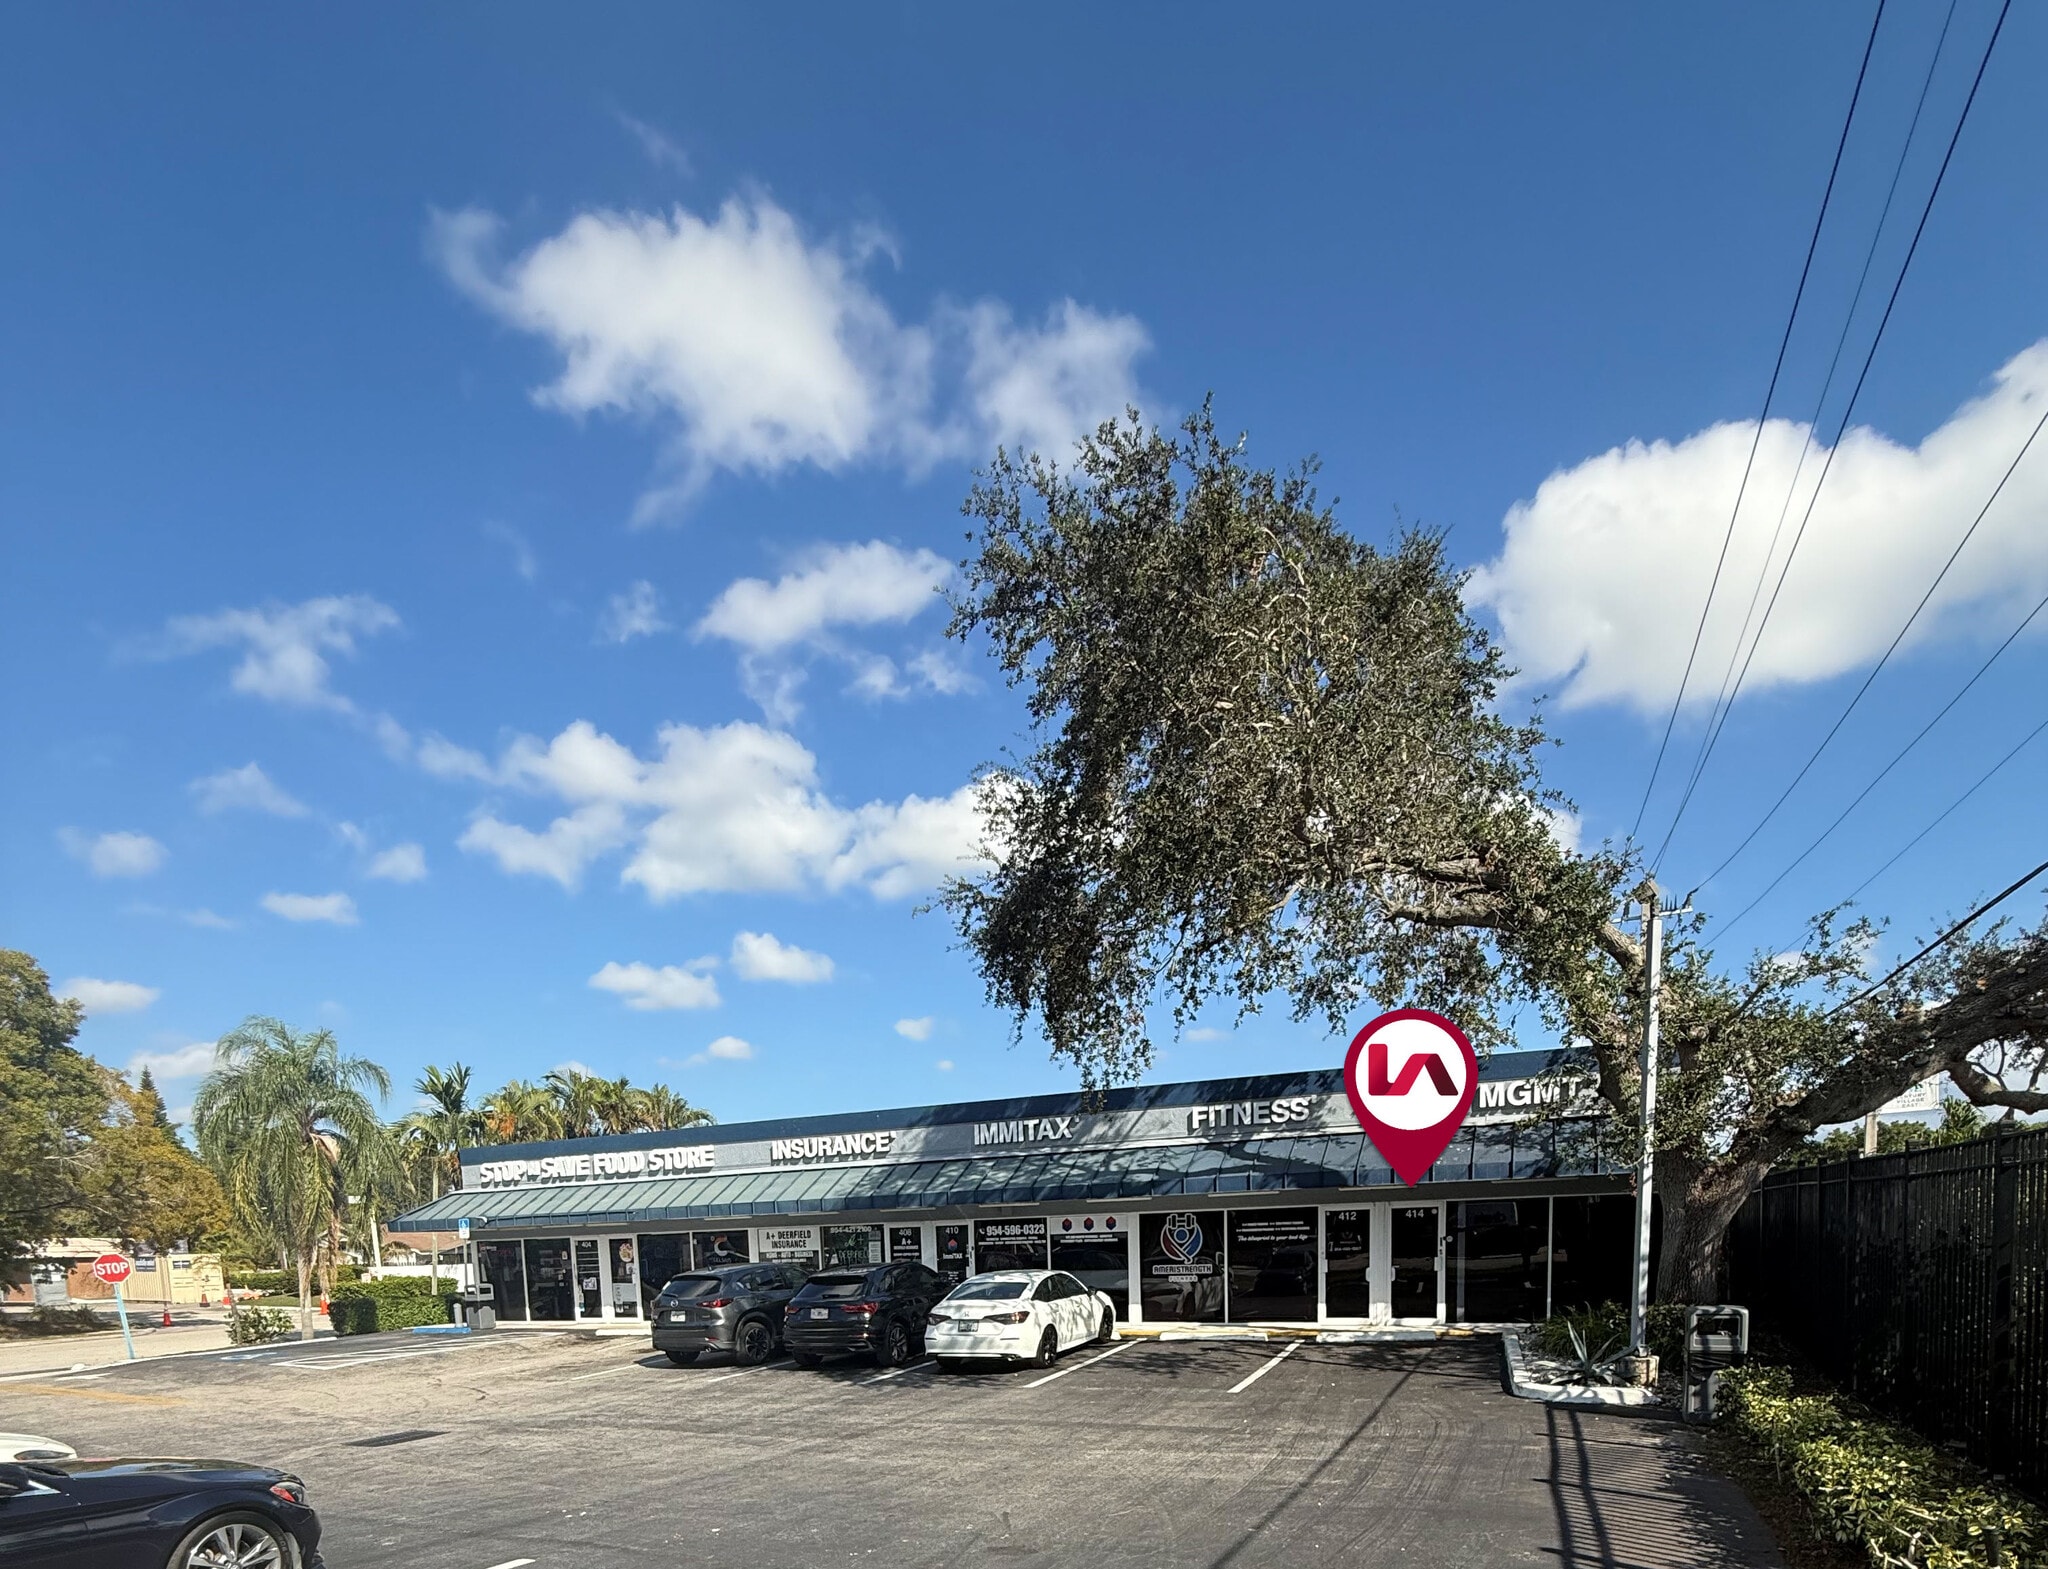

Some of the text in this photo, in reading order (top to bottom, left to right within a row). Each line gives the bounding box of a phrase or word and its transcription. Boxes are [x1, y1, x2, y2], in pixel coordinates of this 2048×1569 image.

[1192, 1097, 1310, 1129] FITNESS
[974, 1117, 1073, 1145] IMMITAX
[772, 1131, 891, 1160] INSURANCE
[480, 1160, 527, 1183] STOP
[541, 1155, 590, 1178] SAVE
[593, 1151, 644, 1175] FOOD
[648, 1145, 715, 1170] STORE
[1338, 1211, 1357, 1221] 412
[1405, 1209, 1424, 1218] 414
[766, 1230, 811, 1240] A+ DEERFIELD
[945, 1226, 959, 1235] 410
[986, 1223, 1045, 1236] 954-596-0323
[771, 1239, 807, 1249] INSURANCE
[96, 1261, 129, 1276] STOP
[1153, 1264, 1212, 1275] AMERISTRENGTH
